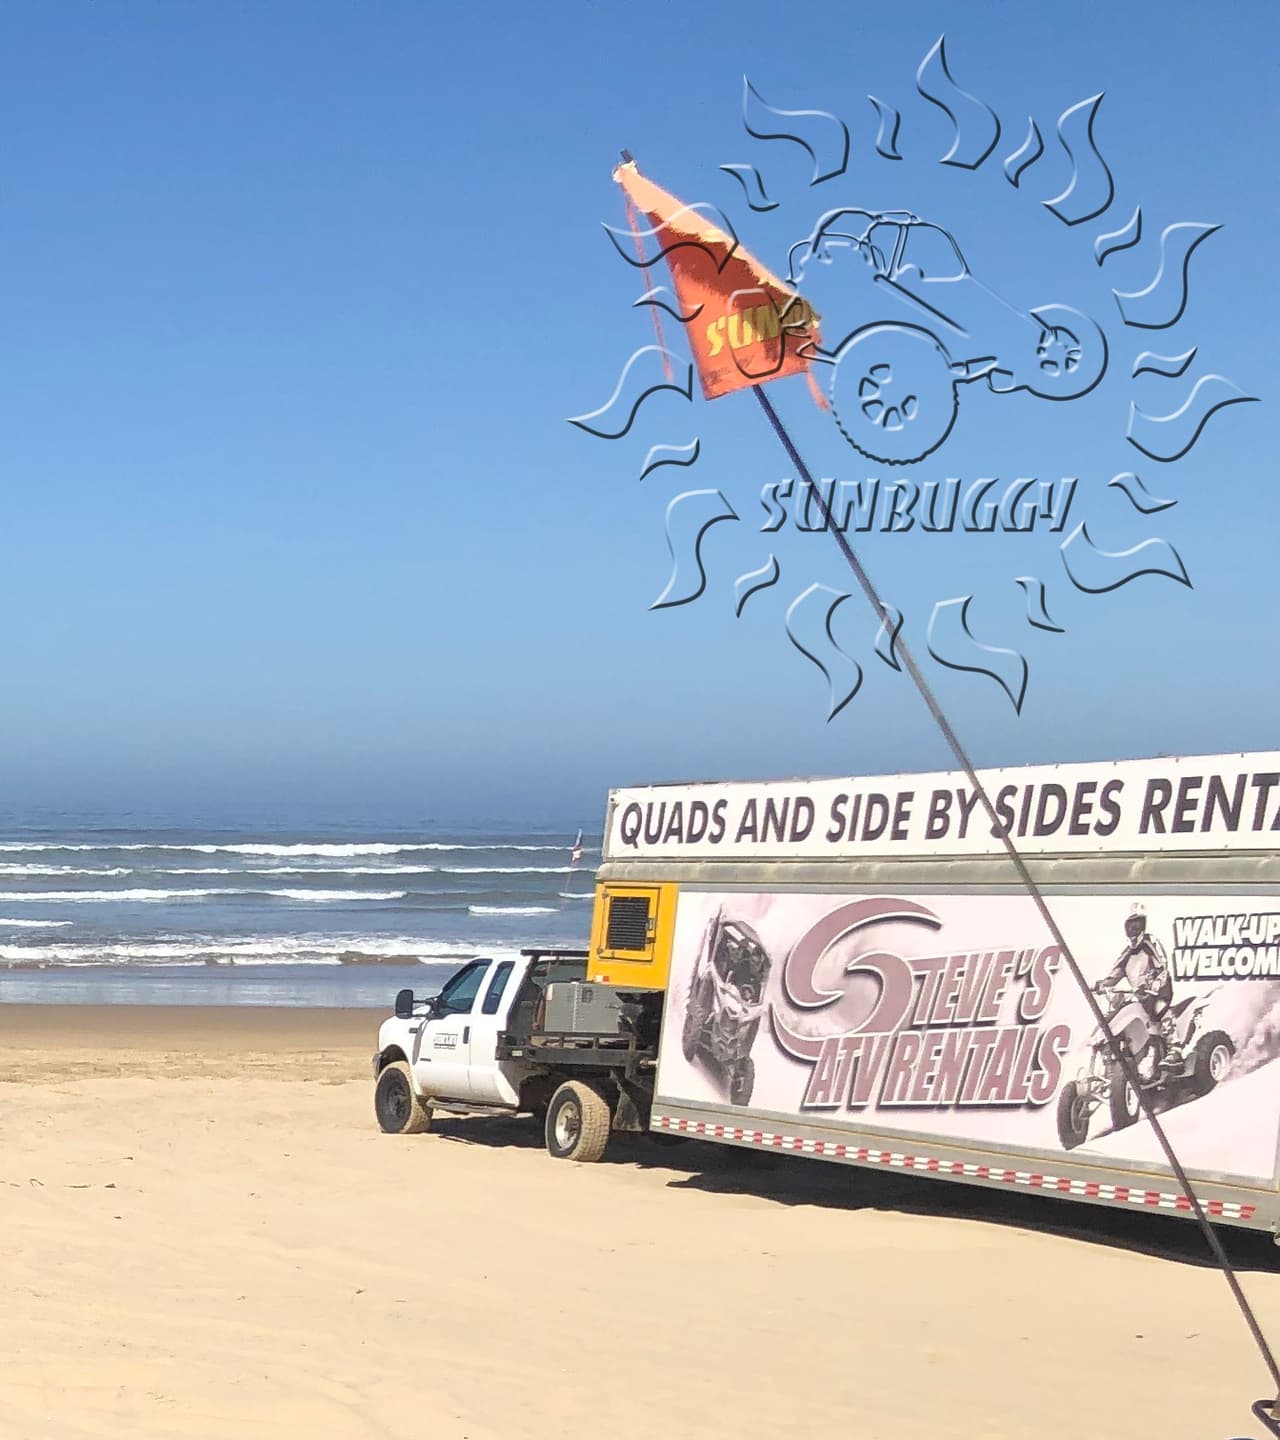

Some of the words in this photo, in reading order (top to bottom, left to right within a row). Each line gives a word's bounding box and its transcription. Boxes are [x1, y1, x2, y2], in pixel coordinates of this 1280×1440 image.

[621, 799, 728, 848] QUADS
[735, 796, 815, 843] AND
[826, 791, 915, 842] SIDE
[925, 788, 981, 839] BY
[990, 779, 1124, 837] SIDES
[1138, 772, 1280, 834] RENT
[769, 896, 1064, 1061] STEVE'S
[1173, 946, 1280, 978] WELCOM
[800, 1035, 892, 1108] ATV
[877, 1024, 1072, 1108] RENTALS
